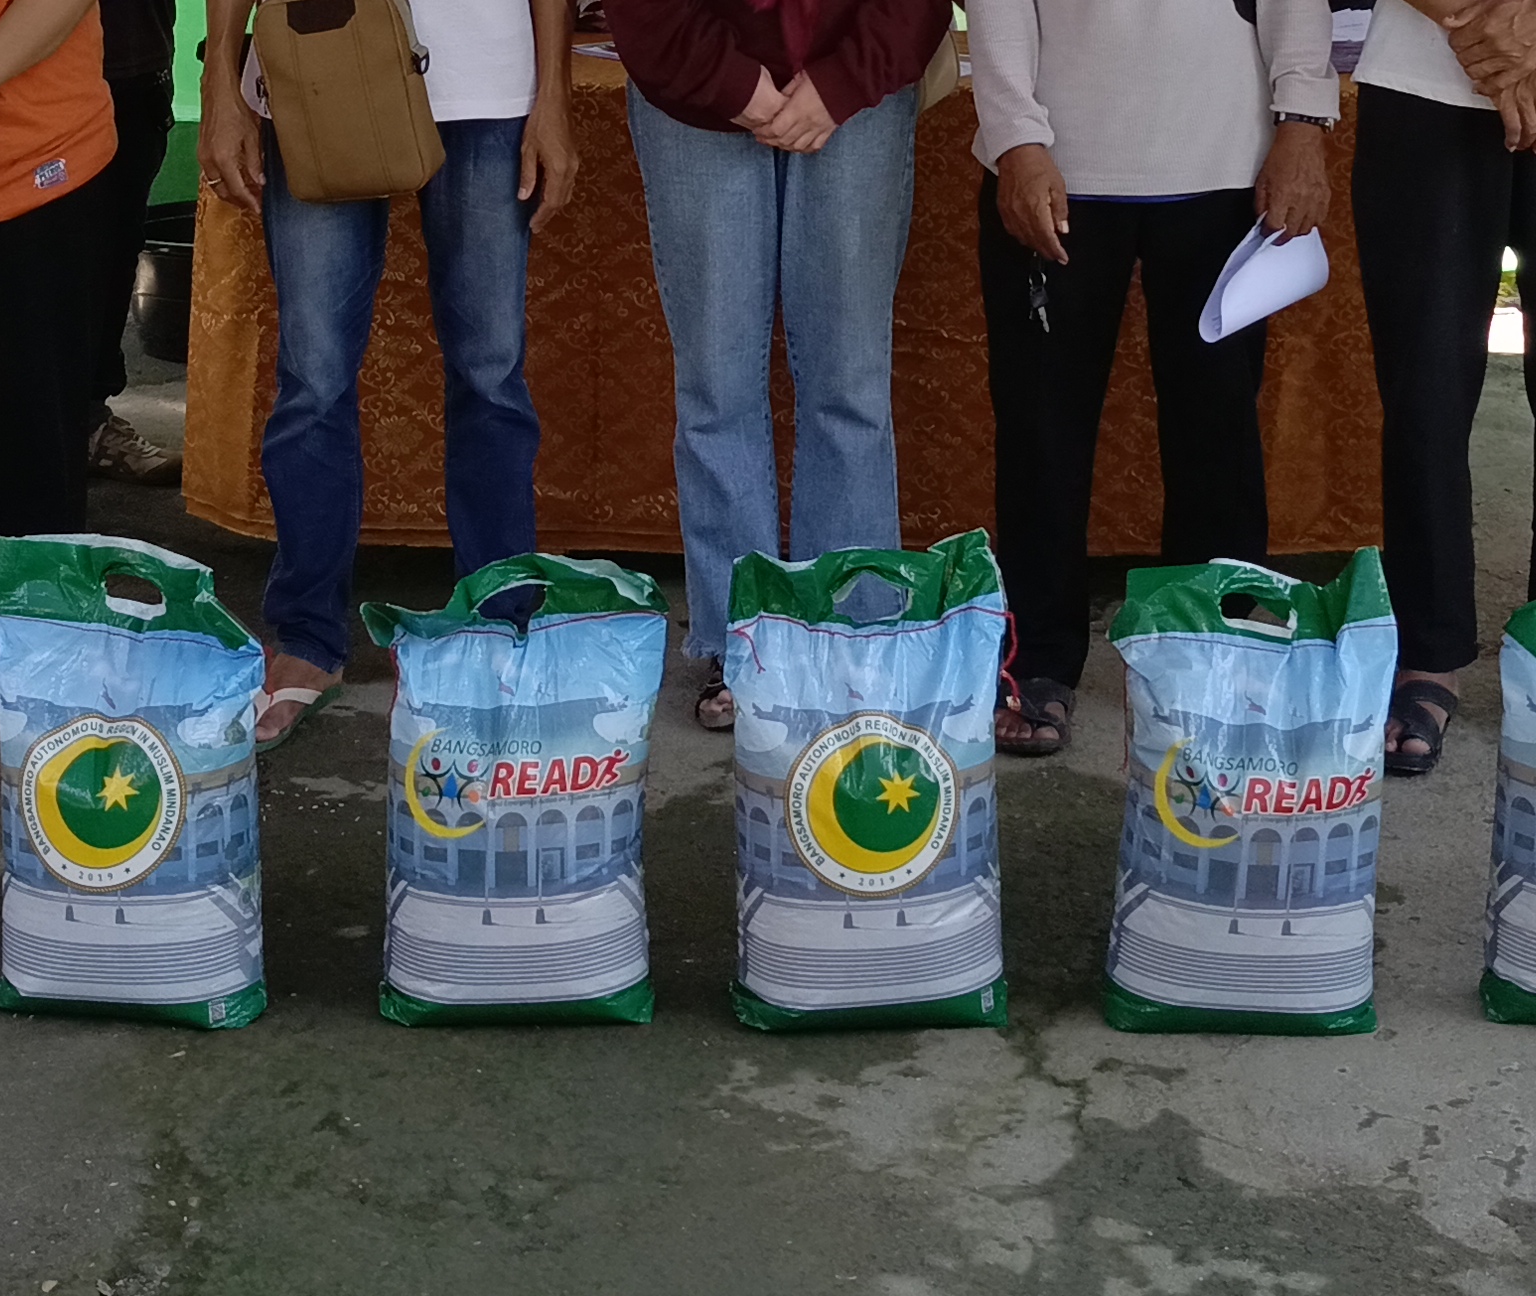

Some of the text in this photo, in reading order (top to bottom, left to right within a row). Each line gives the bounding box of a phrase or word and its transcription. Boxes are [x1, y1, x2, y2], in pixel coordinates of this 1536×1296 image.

[32, 721, 104, 771] AUTONOMOUS
[138, 730, 150, 745] IN
[430, 737, 543, 756] BANGSAMORO
[147, 740, 175, 786] MUSLIM
[488, 755, 600, 799] READ
[24, 772, 51, 856] BANGSAMORO
[793, 719, 953, 867] BANGSAMORO AUTONOMOUS REGION IN MUSLIM MINDANAO
[1243, 776, 1353, 815] READ
[151, 788, 177, 851] MINDANAO
[78, 870, 114, 883] 2019
[858, 875, 896, 887] 2019
